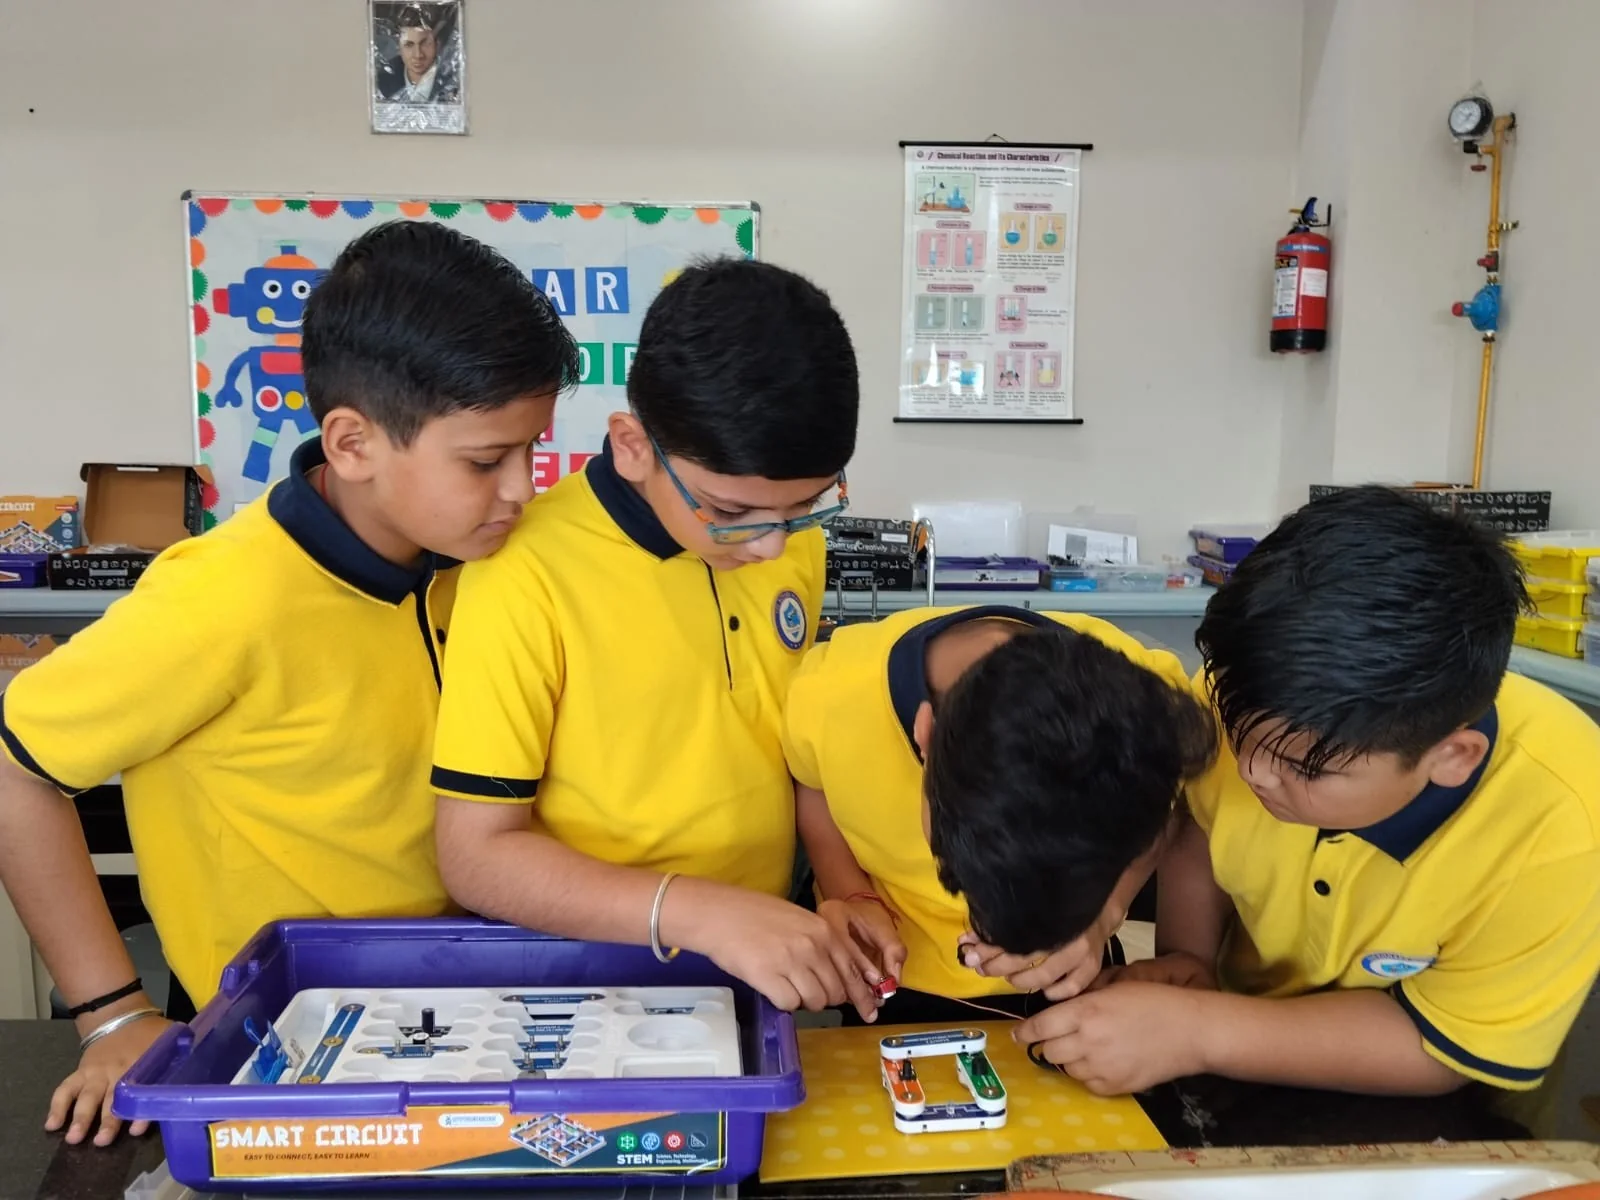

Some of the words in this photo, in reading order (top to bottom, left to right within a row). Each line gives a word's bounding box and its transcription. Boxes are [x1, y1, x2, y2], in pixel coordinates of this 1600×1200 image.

[937, 152, 962, 160] Chemical
[963, 152, 986, 160] Reaction
[1006, 153, 1050, 161] Characteristics
[215, 1125, 304, 1148] SMART
[315, 1123, 423, 1146] CIRCUIT
[244, 1153, 263, 1161] EASY
[265, 1153, 275, 1161] TO
[314, 1152, 333, 1160] EASY
[334, 1152, 344, 1160] TO
[345, 1152, 370, 1160] LEARN
[616, 1153, 653, 1166] STEM
